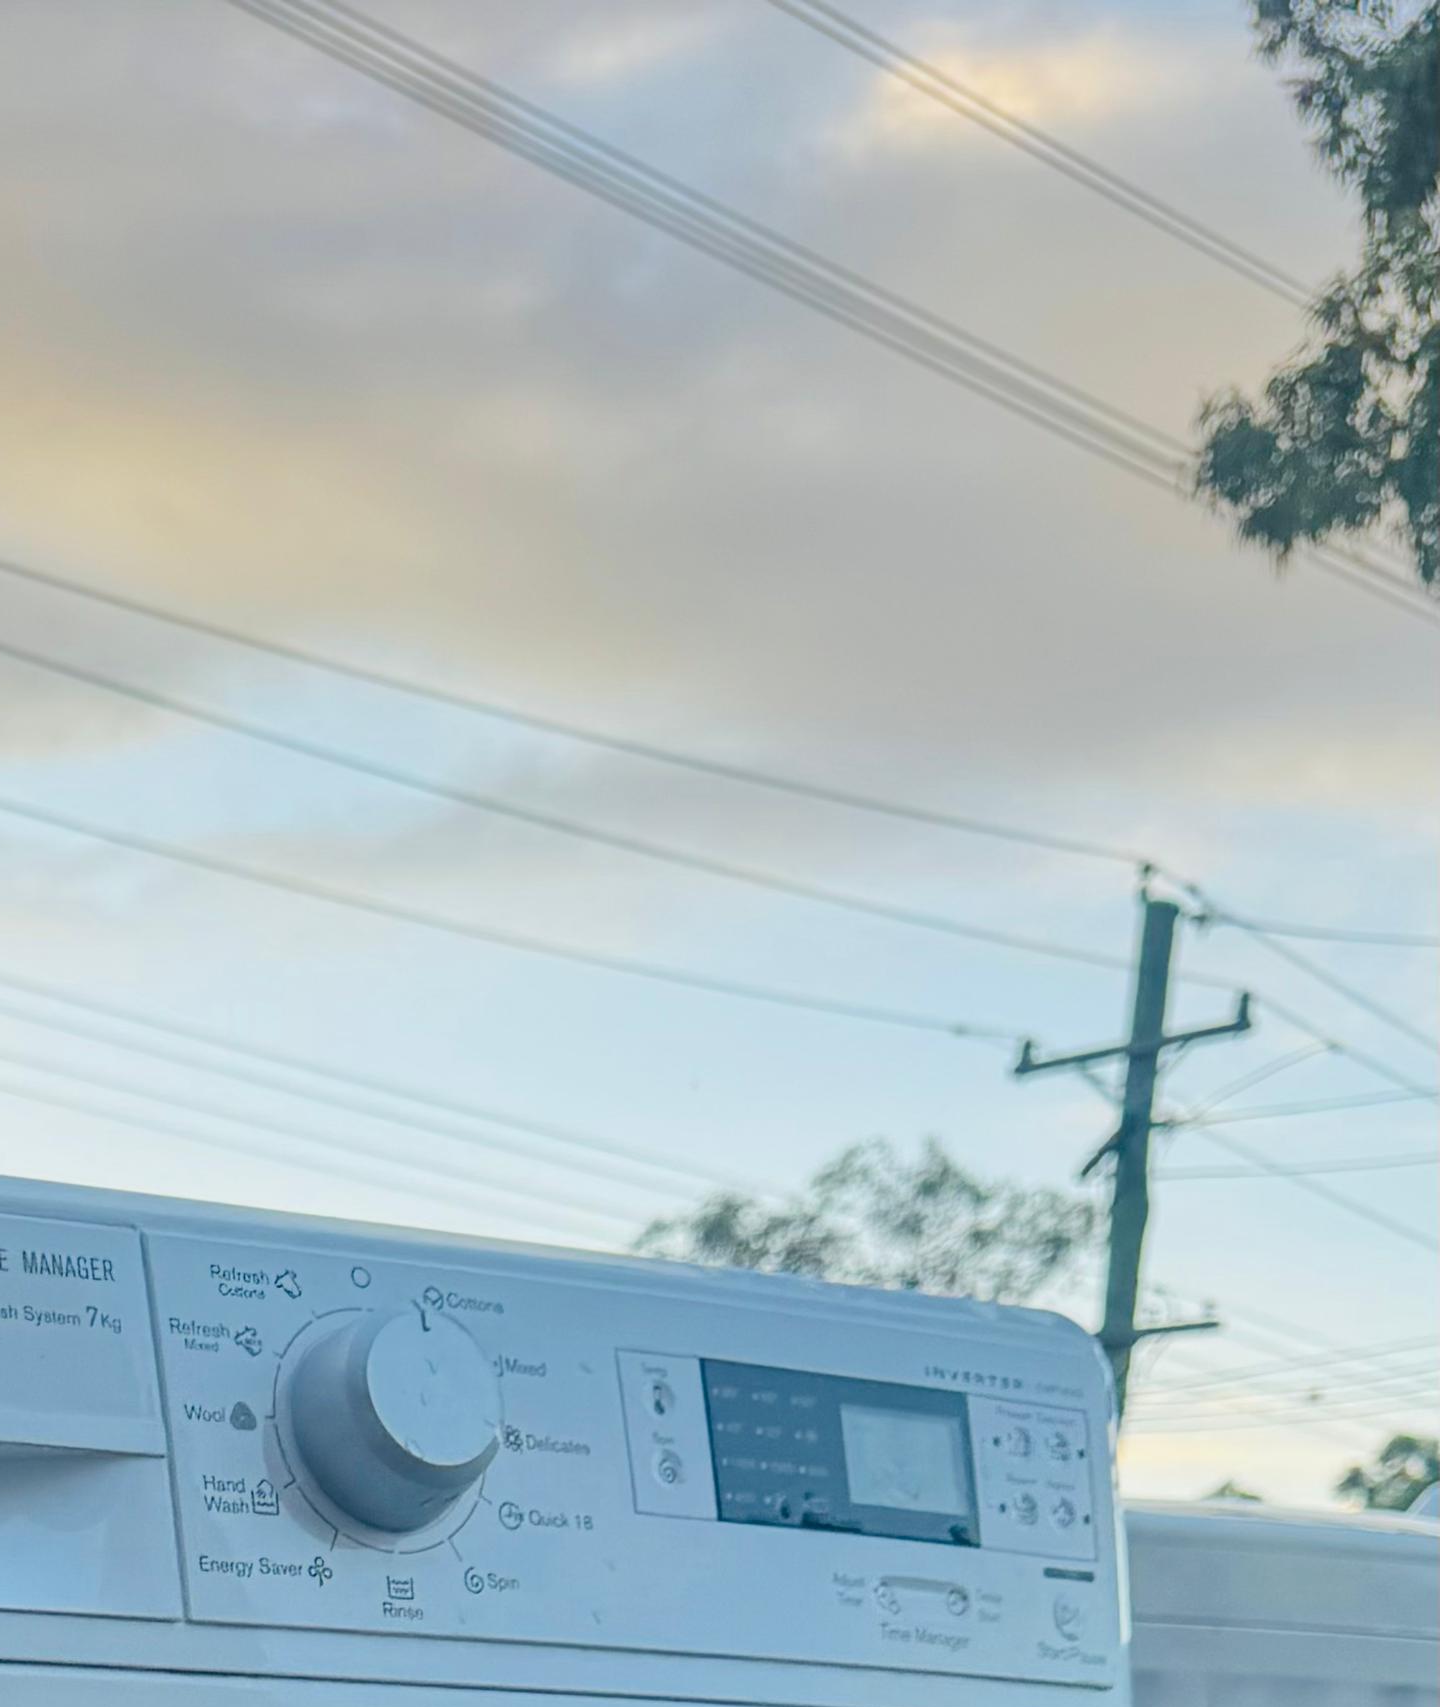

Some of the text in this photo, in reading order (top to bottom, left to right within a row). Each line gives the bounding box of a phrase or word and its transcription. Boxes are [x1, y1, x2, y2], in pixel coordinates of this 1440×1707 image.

[21, 1250, 116, 1282] MANAGER
[209, 1263, 270, 1286] Refresh
[446, 1291, 505, 1315] Cottons
[23, 1304, 81, 1327] System
[86, 1306, 99, 1327] 7
[100, 1312, 122, 1334] Kg
[168, 1316, 231, 1339] Refresh
[504, 1357, 547, 1379] Mixed
[924, 1364, 1023, 1390] INVERTER
[183, 1403, 226, 1423] Wool
[525, 1433, 591, 1457] Delicates
[202, 1474, 246, 1494] Hand
[203, 1495, 250, 1514] Wash
[528, 1509, 568, 1529] Quick
[198, 1555, 303, 1579] Energy Saver
[487, 1573, 521, 1592] Spin
[382, 1601, 424, 1621] Rinse
